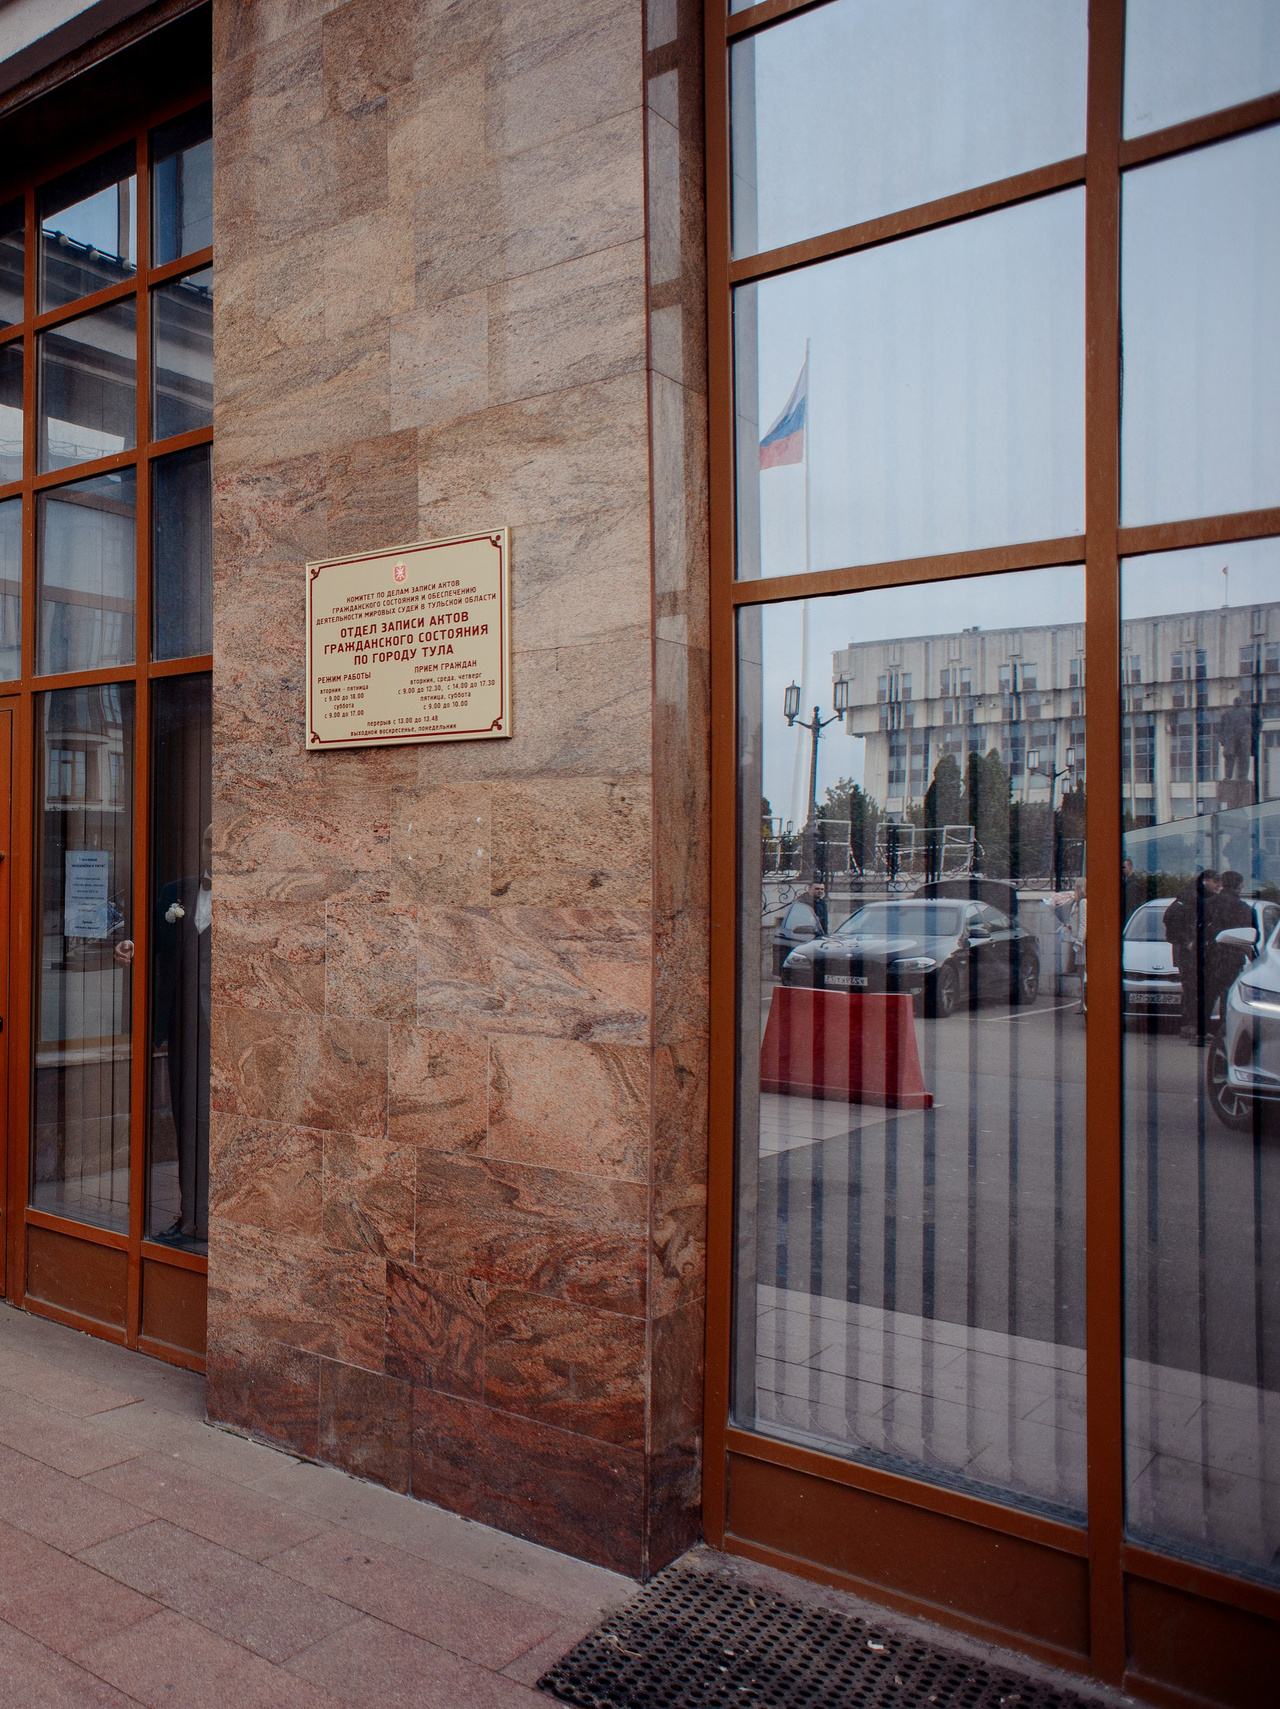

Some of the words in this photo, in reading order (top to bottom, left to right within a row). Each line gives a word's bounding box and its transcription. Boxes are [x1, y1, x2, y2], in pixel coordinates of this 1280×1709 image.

[346, 592, 375, 603] КОМИТЕТ
[376, 591, 385, 599] ПО
[386, 587, 410, 598] ДЕЛАМ
[411, 583, 436, 594] ЗАПИСИ
[438, 579, 460, 589] АКТОВ
[332, 601, 381, 614] ГРАЖДАНСКОГО
[382, 595, 419, 607] СОСТОЯНИЯ
[427, 586, 477, 600] ОБЕСПЕЧЕНИЮ
[315, 612, 363, 626] ДЕЯТЕЛЬНОСТИ
[364, 607, 396, 618] МИРОВЫХ
[397, 604, 419, 614] СУДЕЙ
[427, 598, 463, 609] ТУЛЬСКОЙ
[464, 593, 497, 604] ОБЛАСТИ
[340, 623, 377, 639] ОТДЕЛ
[381, 617, 425, 633] ЗАПИСИ
[429, 611, 469, 627] АКТОВ
[324, 633, 414, 655] ГРАЖДАНСКОГО
[418, 623, 489, 643] СОСТОЯНИЯ
[354, 654, 368, 666] ПО
[372, 648, 417, 664] ГОРОДУ
[421, 643, 454, 658] ТУЛА
[414, 663, 439, 674] ПРИЕМ
[440, 659, 477, 671] ГРАЖДАН
[317, 675, 342, 684] РЕЖИМ
[343, 671, 371, 682] РАБОТЫ
[458, 672, 482, 680] четверг
[347, 684, 369, 692] пятница
[402, 687, 415, 695] 9.00
[479, 679, 496, 687] 17.30
[328, 694, 341, 702] 9.00
[350, 692, 365, 700] 18.00
[447, 691, 471, 700] суббота
[333, 703, 355, 711] суббота
[428, 702, 441, 710] 9.00
[452, 700, 468, 708] 10.00
[328, 711, 341, 719] 9.00
[350, 709, 365, 717] 17.00
[367, 719, 392, 727] перерыв
[397, 716, 413, 725] 13.00
[350, 729, 378, 737] выходной
[418, 723, 457, 731] понедельник
